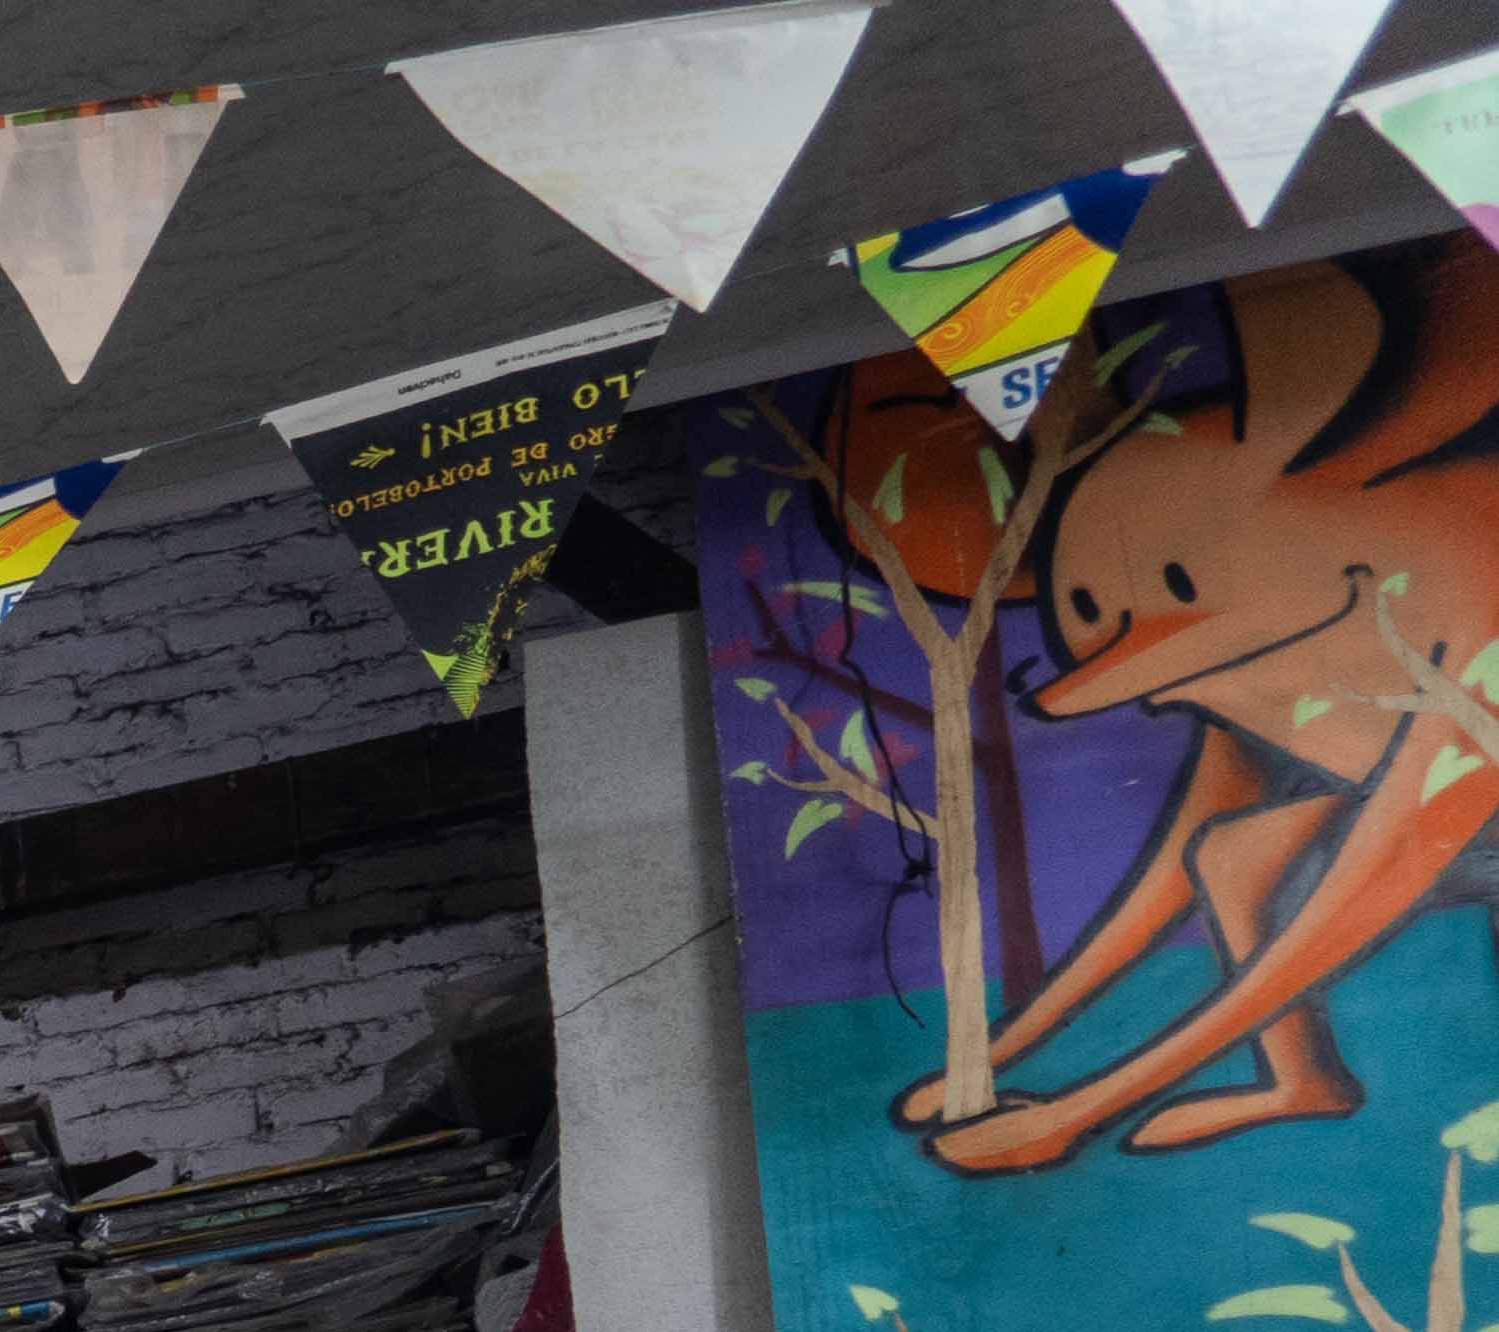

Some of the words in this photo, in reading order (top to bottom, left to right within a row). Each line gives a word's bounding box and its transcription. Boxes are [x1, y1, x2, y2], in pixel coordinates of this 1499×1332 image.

[420, 395, 540, 459] BIEN!
[510, 440, 550, 469] DE
[518, 462, 578, 488] VIVA
[361, 498, 556, 579] RIVER
